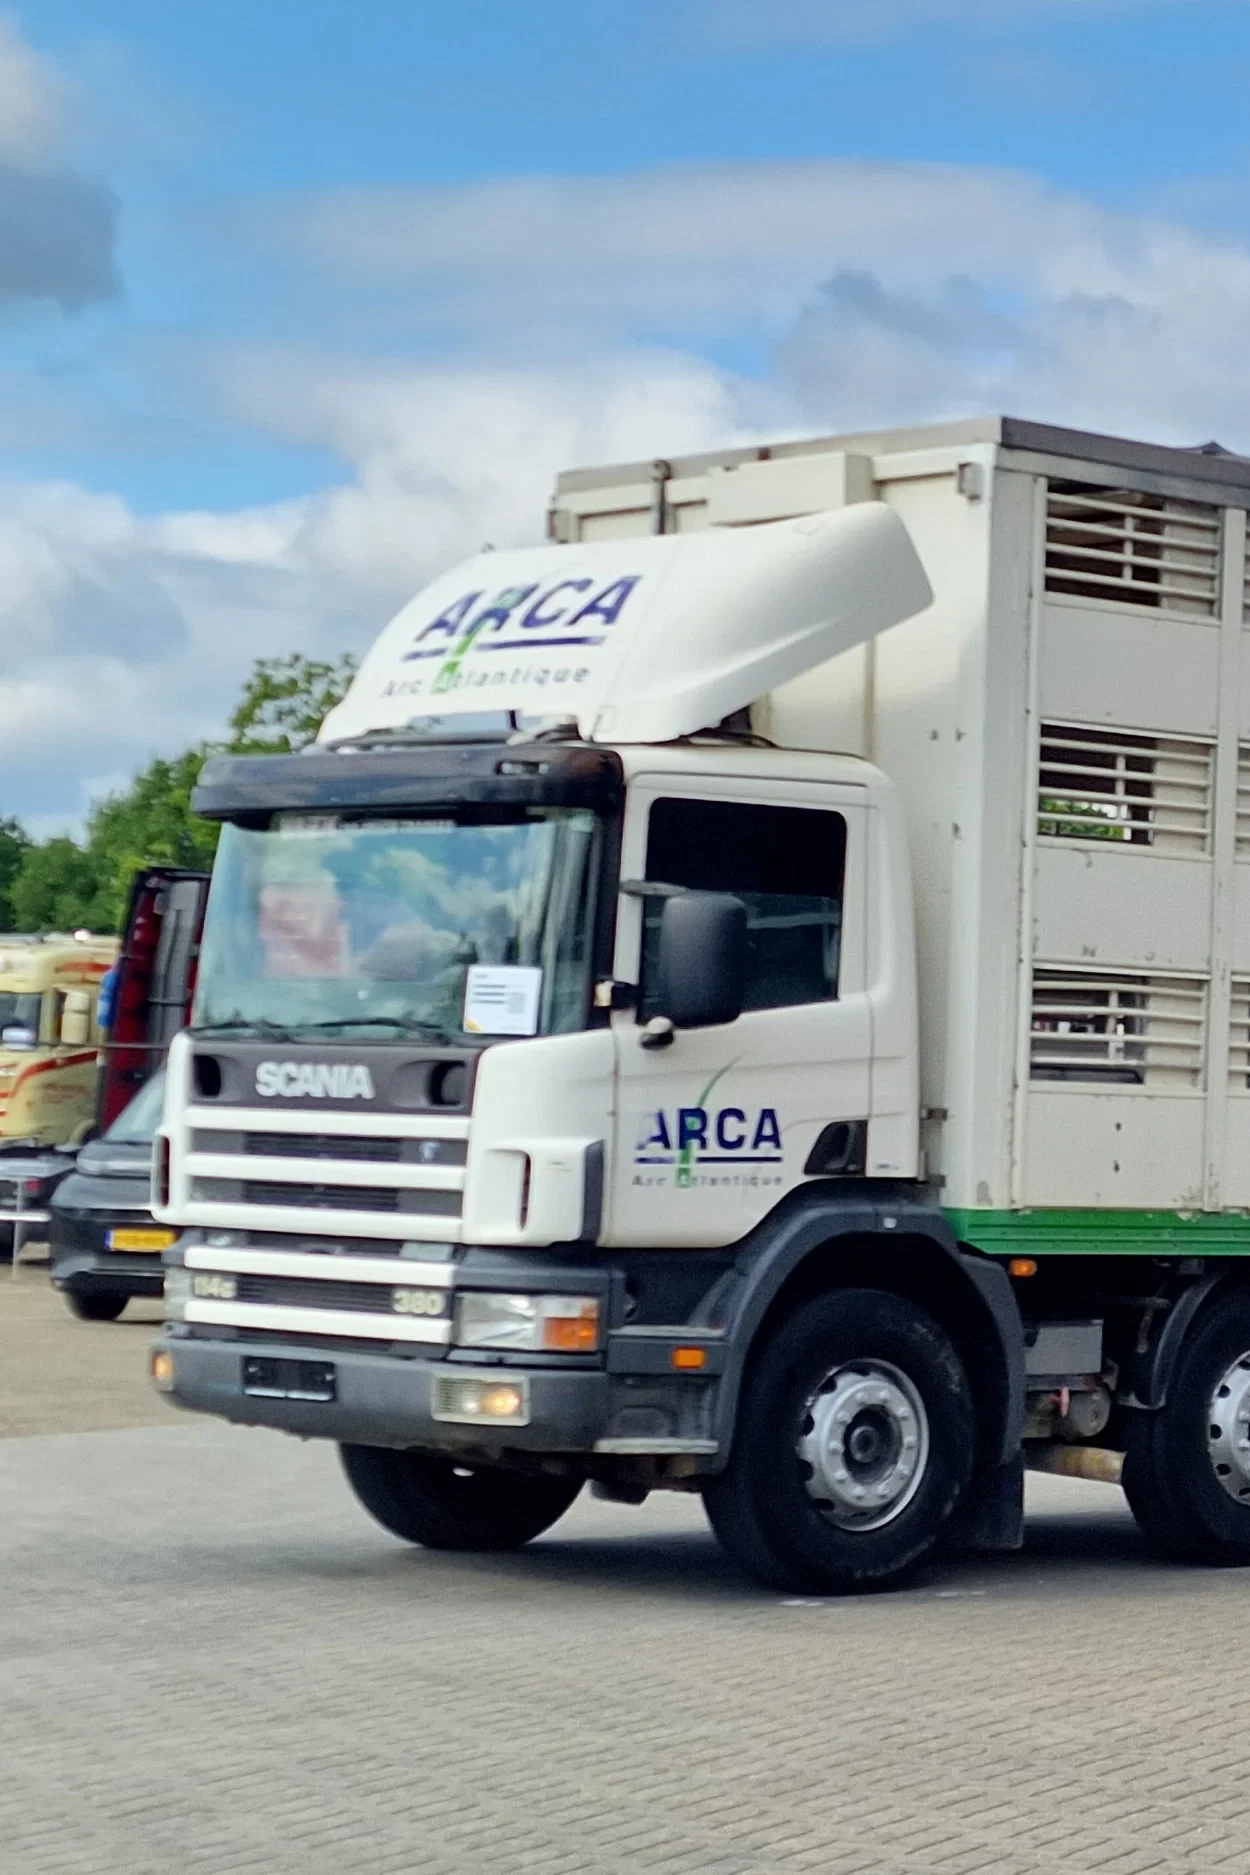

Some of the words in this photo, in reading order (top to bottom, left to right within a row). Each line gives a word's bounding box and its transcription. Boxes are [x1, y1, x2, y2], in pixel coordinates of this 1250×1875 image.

[414, 575, 642, 642] ARCA
[255, 1061, 376, 1099] SCANIA
[635, 1107, 782, 1150] ARCA
[393, 1290, 445, 1315] 380
